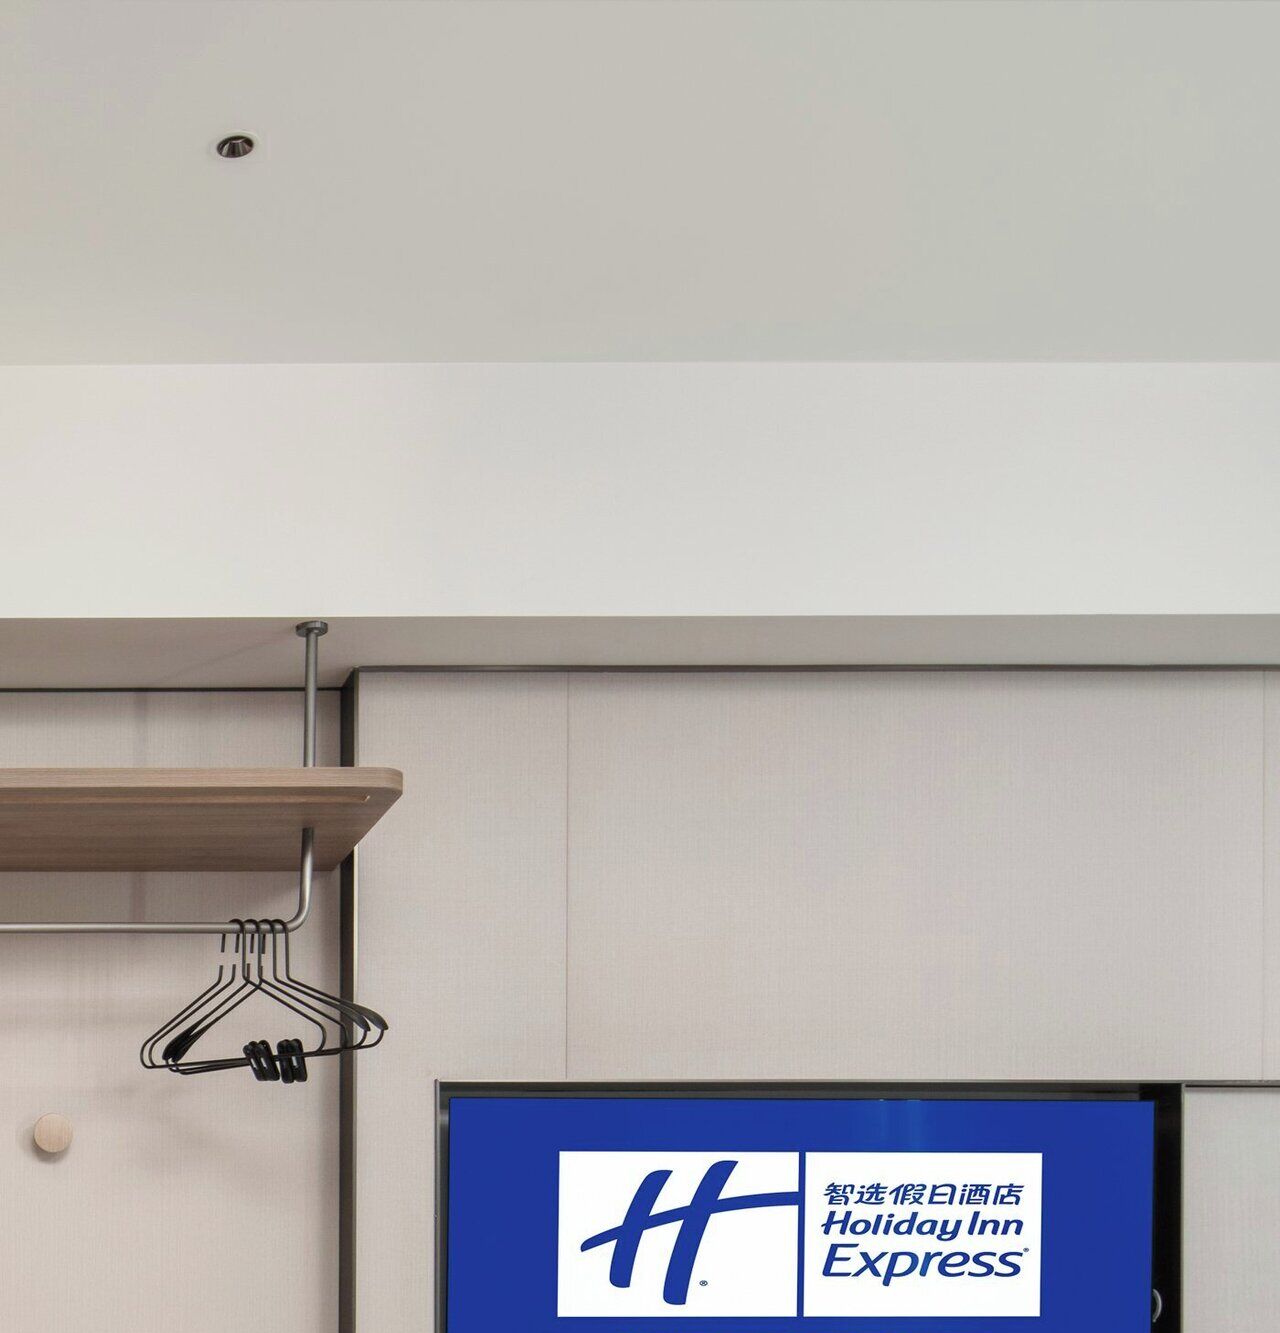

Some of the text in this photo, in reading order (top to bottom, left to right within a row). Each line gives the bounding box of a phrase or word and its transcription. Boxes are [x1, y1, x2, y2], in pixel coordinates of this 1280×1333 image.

[822, 1182, 1025, 1206] 智选假日酒店
[820, 1210, 1024, 1242] Holiday Inn
[821, 1243, 1025, 1287] Express
